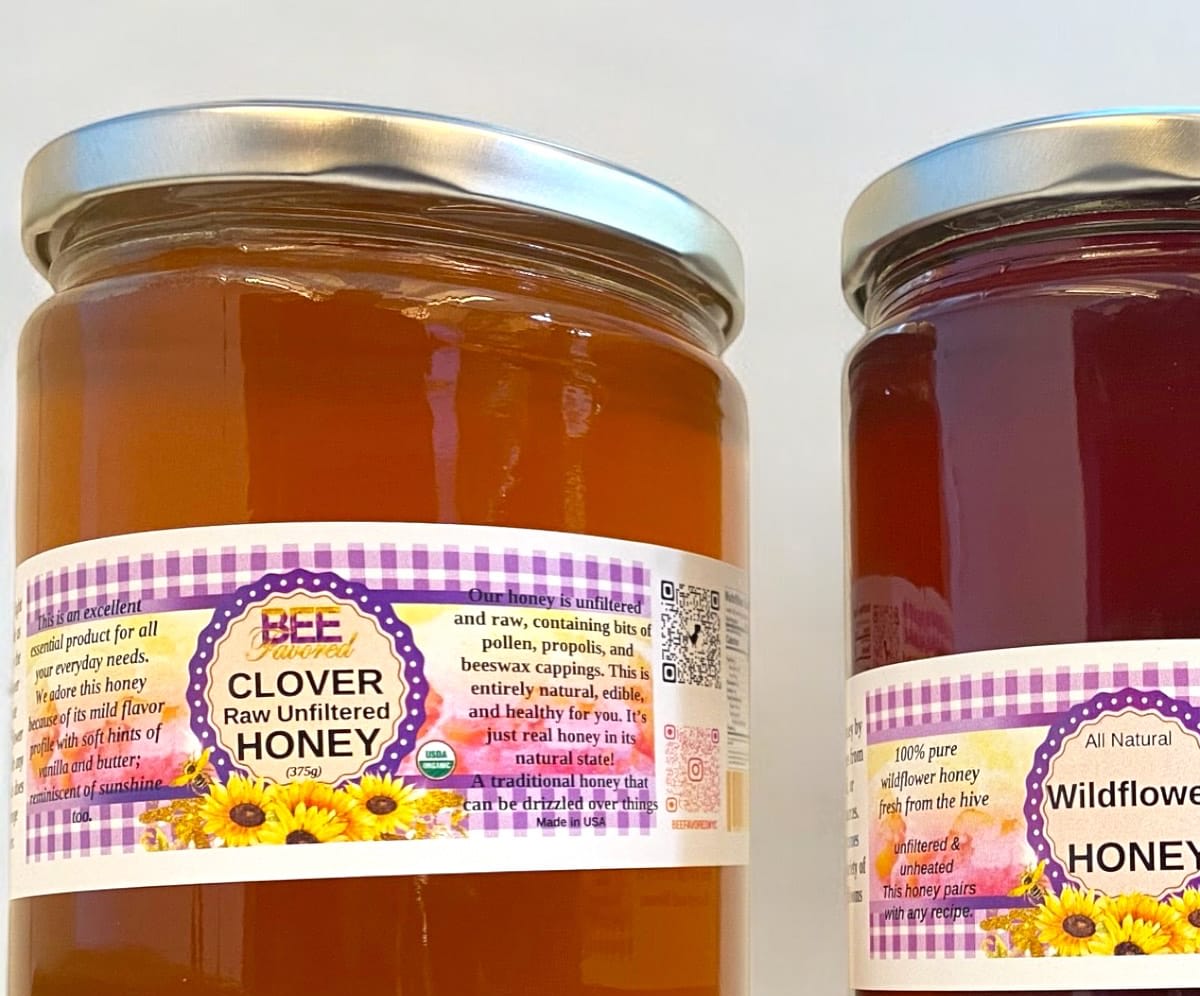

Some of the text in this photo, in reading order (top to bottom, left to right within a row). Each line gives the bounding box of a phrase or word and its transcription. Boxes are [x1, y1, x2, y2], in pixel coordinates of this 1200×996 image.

[84, 599, 142, 619] excellent
[468, 588, 642, 614] Our honey unfiltered
[261, 606, 343, 645] BEE
[454, 611, 637, 636] and raw, containing bits
[30, 620, 157, 657] essential product for all
[246, 627, 357, 662] Favored
[482, 636, 633, 657] pollen, propolis, and
[35, 648, 149, 685] your everyday needs.
[461, 658, 636, 680] beeswax cappings. This
[50, 677, 147, 700] adore this honey
[228, 669, 383, 699] CLOVER
[471, 682, 644, 702] entirely natural, edible,
[28, 700, 165, 732] because mild flavor
[224, 702, 390, 724] Raw Unfiltered
[468, 705, 647, 724] and healthy for you. It's
[30, 723, 162, 760] profile with soft hints of
[238, 728, 380, 761] HONEY
[486, 727, 636, 747] just real honey its
[1085, 731, 1172, 748] All Natural
[516, 752, 614, 766] natural state!
[895, 744, 957, 762] 100% pure
[39, 755, 140, 778] vanilla and butter;
[286, 765, 322, 779] (375g)
[30, 776, 162, 804] reminiscent sunshine
[472, 775, 648, 790] A traditional honey that
[881, 767, 980, 791] wildflower honey
[463, 797, 658, 814] can be drizzled over things
[879, 799, 902, 818] fresh
[905, 796, 933, 816] from
[937, 793, 955, 809] the
[960, 792, 989, 808] hive
[537, 816, 606, 828] Made USA
[894, 838, 947, 854] unfiltered
[900, 860, 954, 876] unheated
[883, 882, 976, 900] This honey pairs
[885, 904, 973, 922] with any recipe.
